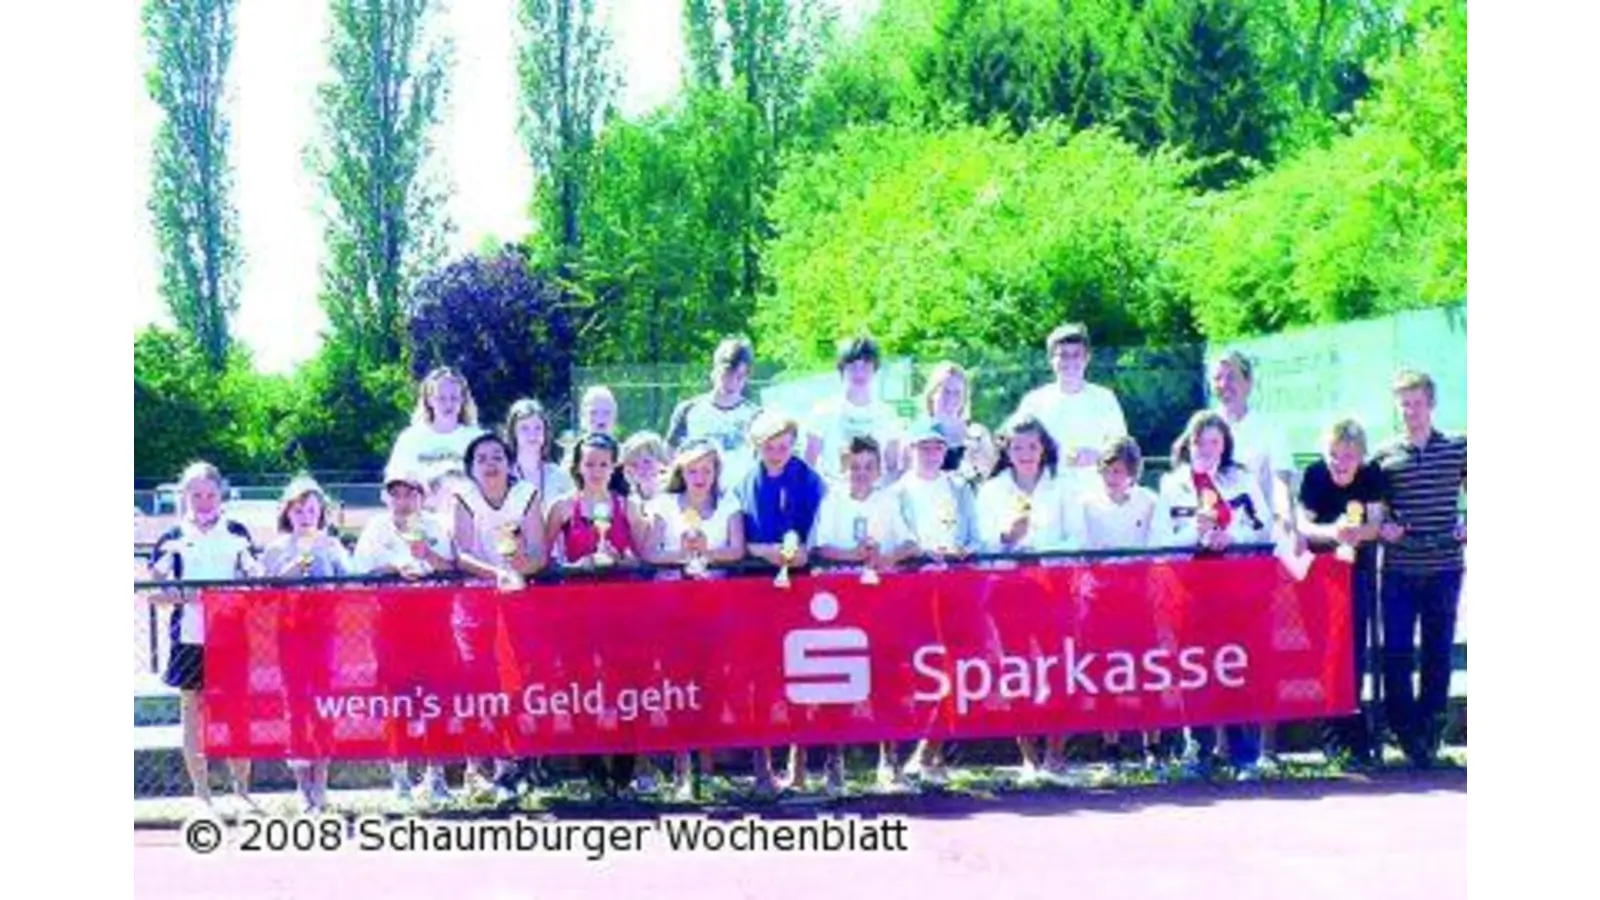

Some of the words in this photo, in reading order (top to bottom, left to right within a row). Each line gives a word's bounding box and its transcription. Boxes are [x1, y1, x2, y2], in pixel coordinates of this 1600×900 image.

[315, 687, 441, 719] wenn's
[453, 691, 509, 718] um
[522, 681, 603, 716] Geld
[616, 679, 702, 720] geht
[912, 637, 1249, 714] Sparkasse
